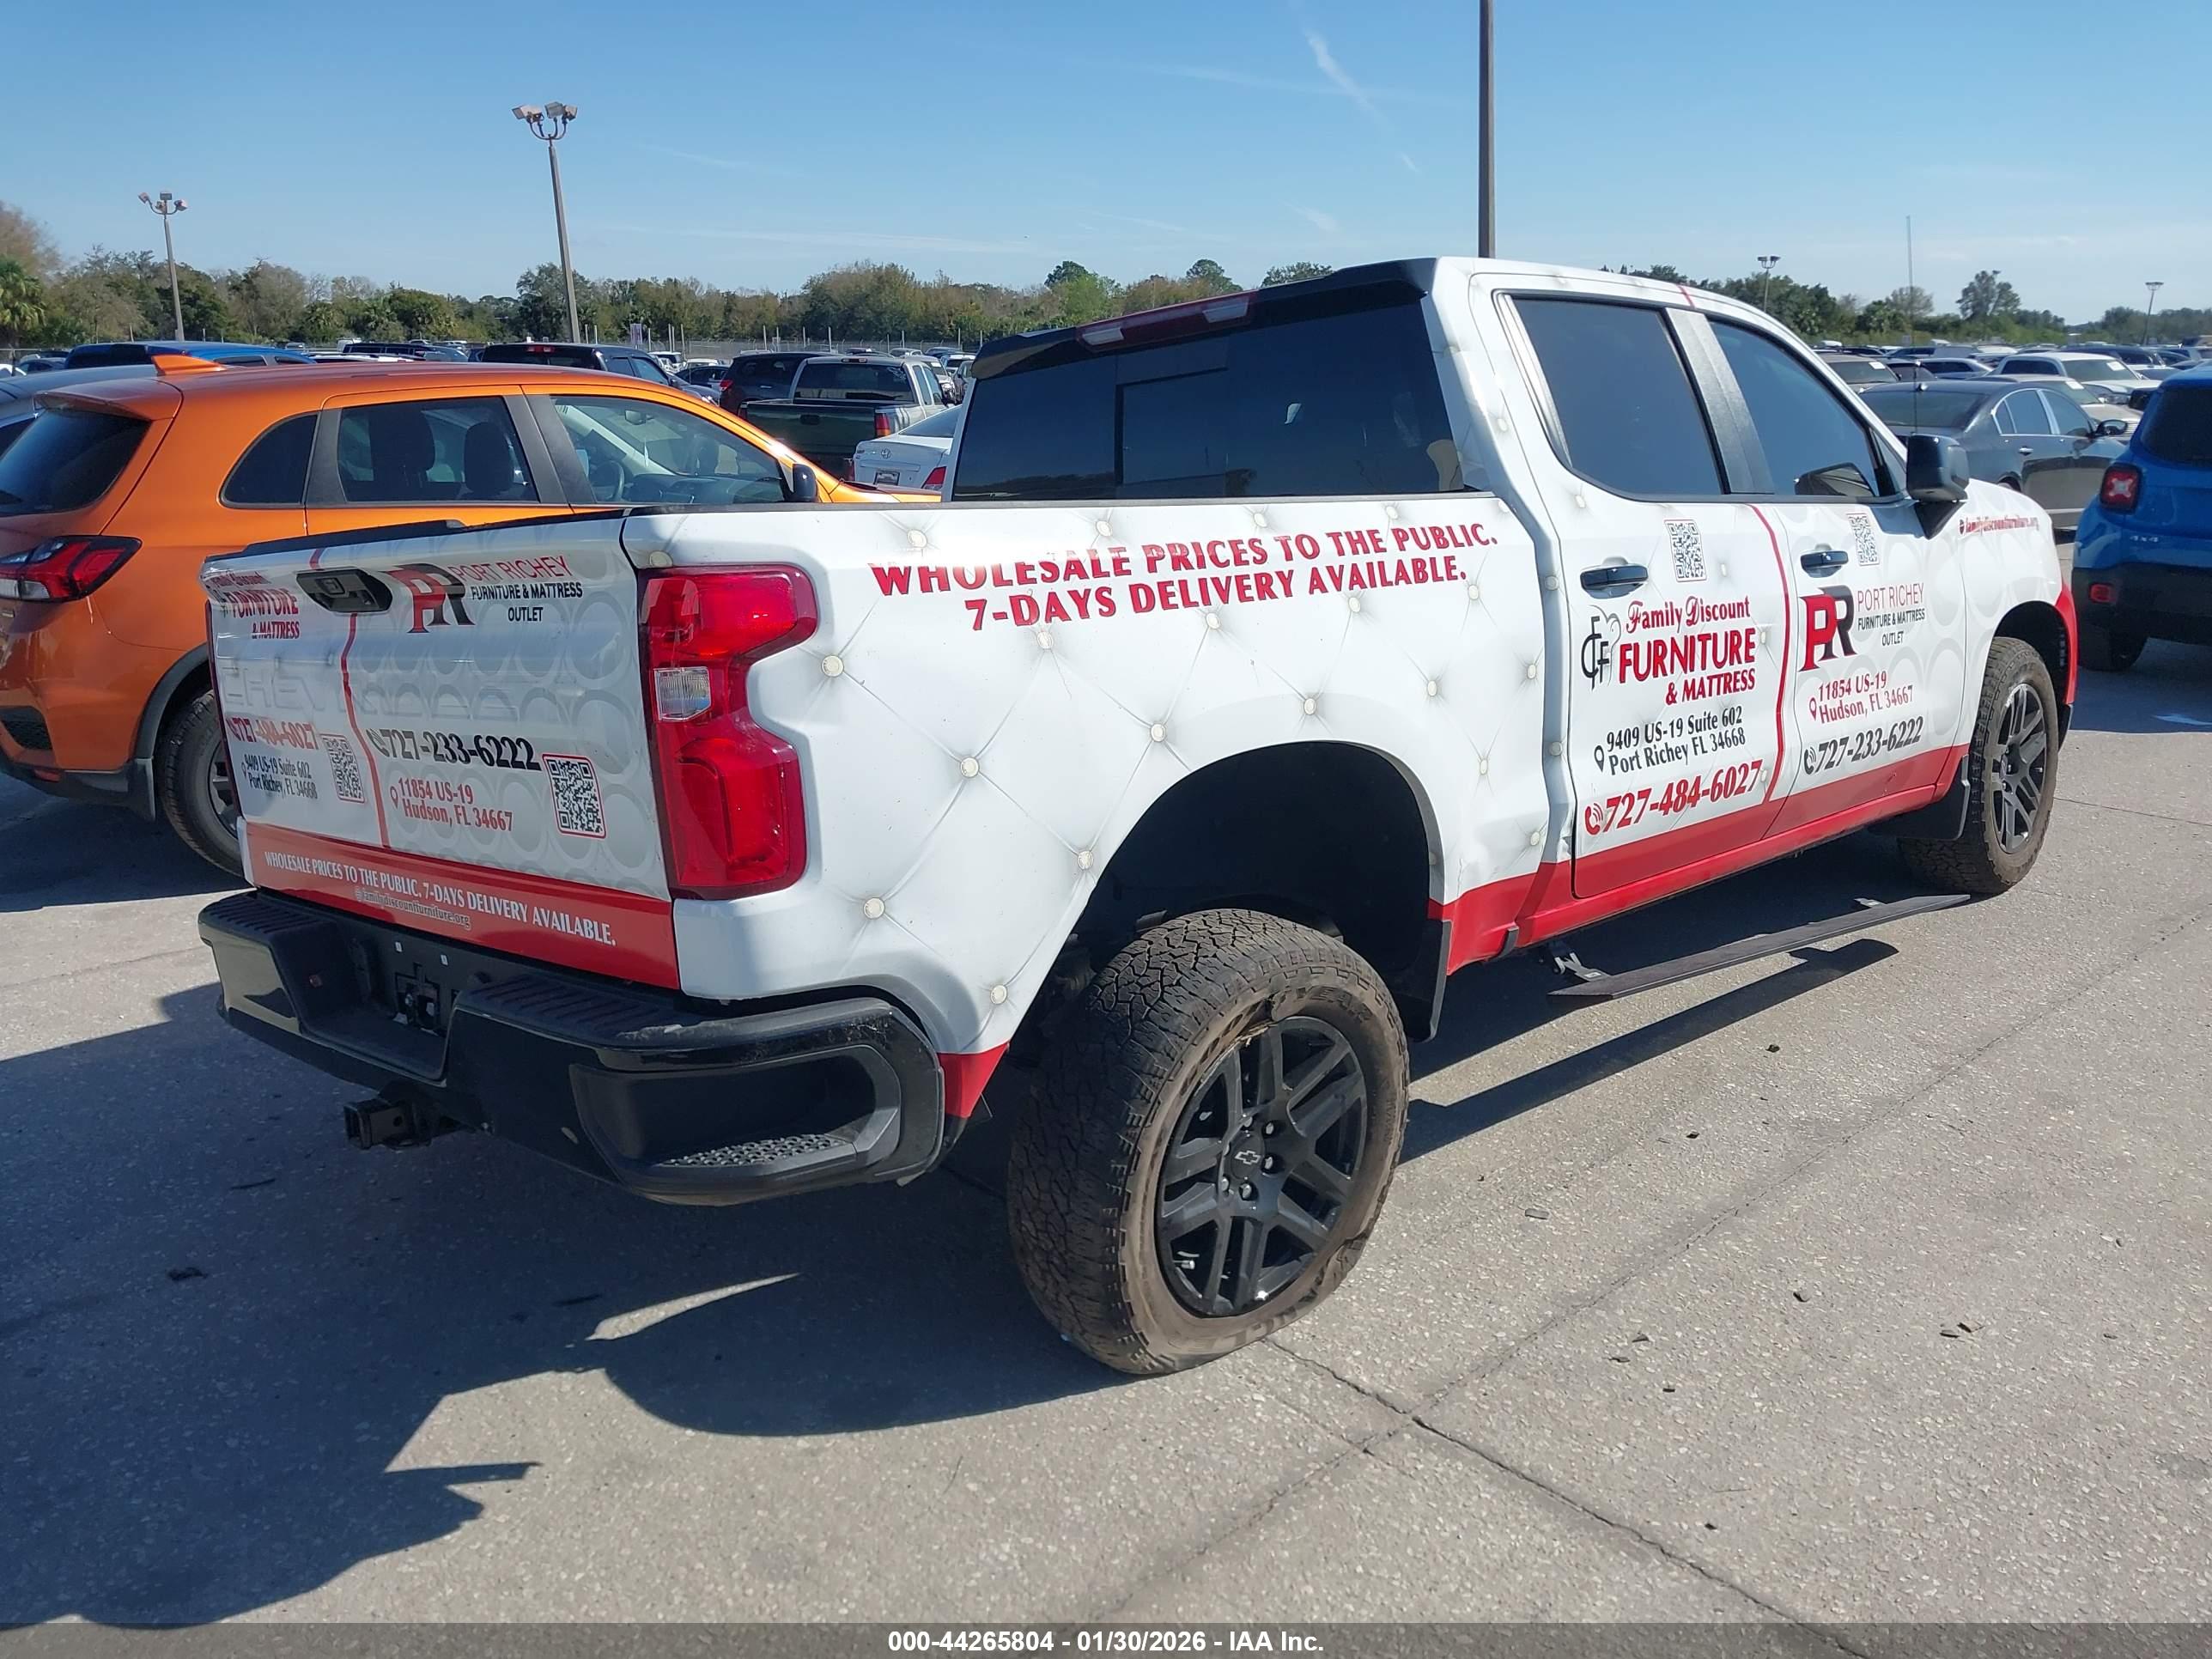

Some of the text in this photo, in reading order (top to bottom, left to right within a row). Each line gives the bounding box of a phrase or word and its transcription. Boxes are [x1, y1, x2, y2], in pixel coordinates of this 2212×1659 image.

[447, 556, 574, 583] PORT RICHEY
[867, 523, 1498, 596] WHOLESALE PRICES TO THE PUBLIC.
[471, 581, 583, 601] FURNITURE & MATTRESS
[964, 556, 1467, 631] 7-DAYS DELIVERY AVAILABLE.
[1857, 582, 1924, 612] PORT RICHEY
[258, 621, 301, 640] MATTRESS
[507, 606, 544, 622] OUTLET
[1626, 596, 1751, 635] Family Discount
[1857, 608, 1925, 631] FURNITURE & MATTRESS
[1619, 628, 1756, 684] FURNITURE
[1881, 631, 1905, 647] OUTLET
[1665, 668, 1756, 706] & MATTRESS
[1819, 671, 1887, 702] 11854 US-19
[1819, 684, 1913, 724] Hudson, FL 34667
[1607, 705, 1743, 752] 9409 US-19 Suite 602
[1815, 715, 1924, 773] 727-233-6222
[258, 755, 278, 775] US-19
[278, 757, 296, 777] Suite
[296, 761, 312, 780] 602
[381, 728, 543, 771] 727-233-6222
[1608, 726, 1747, 775] Port Richey FL 34668
[248, 772, 263, 791] Port
[285, 777, 295, 795] FL
[295, 779, 319, 799] 34668
[398, 777, 473, 805] 11854 US-19
[1602, 759, 1764, 833] 727-484-6027
[402, 798, 513, 832] Hudson, FL 34667
[264, 851, 617, 946] WHOLESALE PRICES TO THE PUBLIC. 7-DAYS DELIVERY AVAILABLE.
